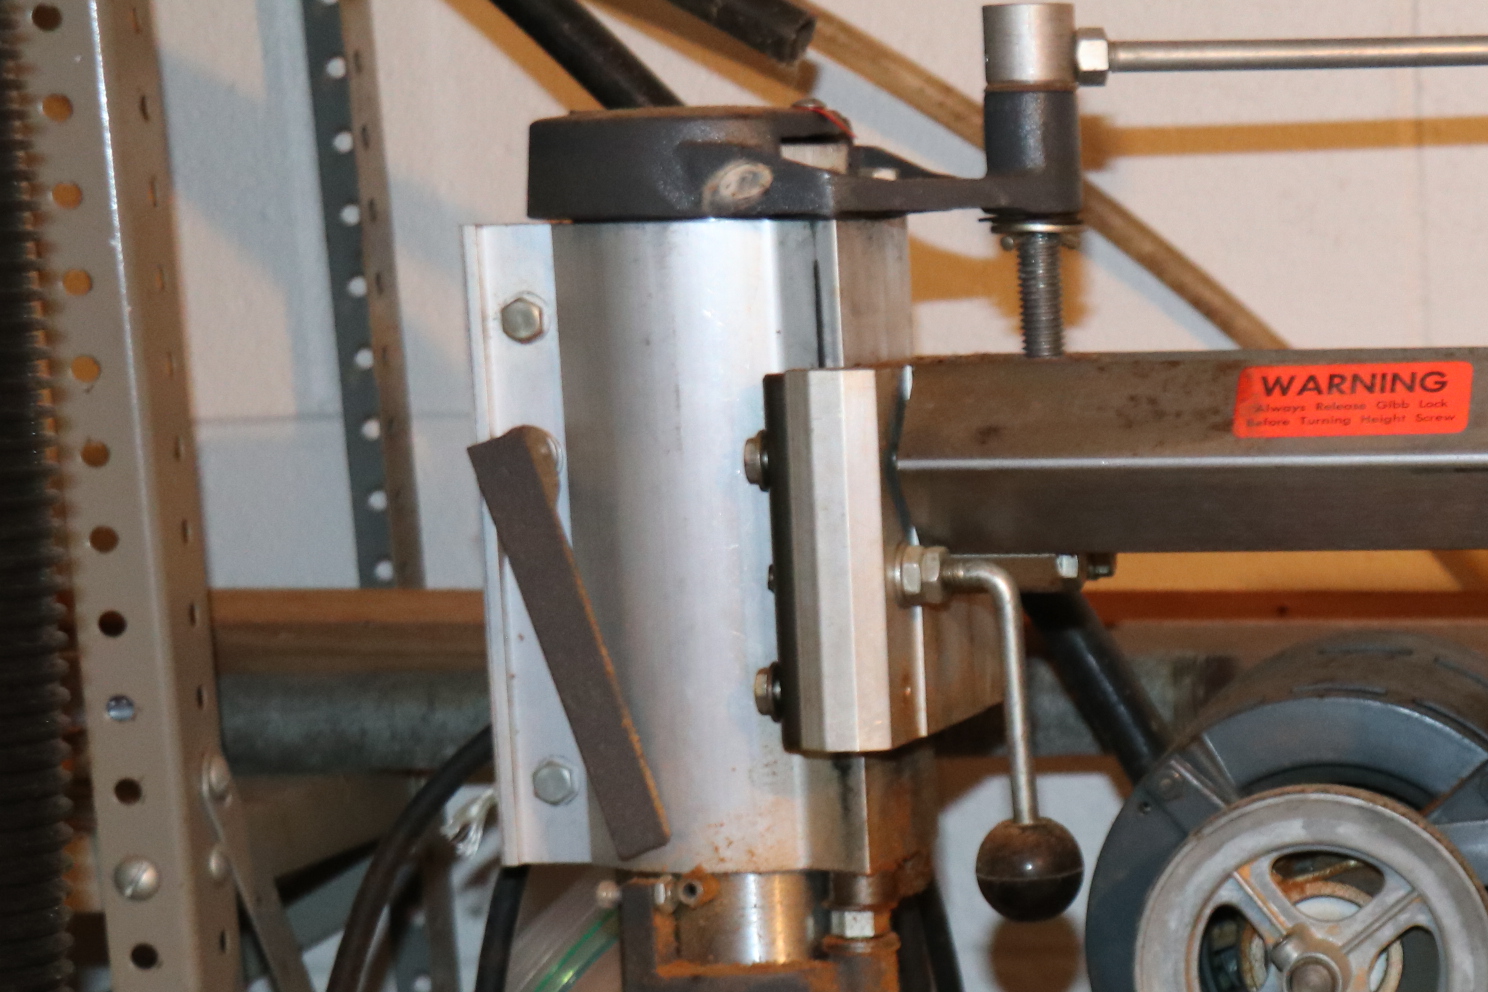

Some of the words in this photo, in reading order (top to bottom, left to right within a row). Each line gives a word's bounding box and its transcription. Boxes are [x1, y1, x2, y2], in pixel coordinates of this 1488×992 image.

[1261, 370, 1448, 397] WARNING
[1253, 403, 1306, 414] Always
[1315, 401, 1367, 412] Release
[1375, 400, 1410, 410] Gibb
[1419, 398, 1448, 409] Lock
[1246, 417, 1291, 428] Before
[1300, 416, 1351, 429] Turning
[1360, 413, 1407, 426] Height
[1415, 412, 1456, 423] Screw
